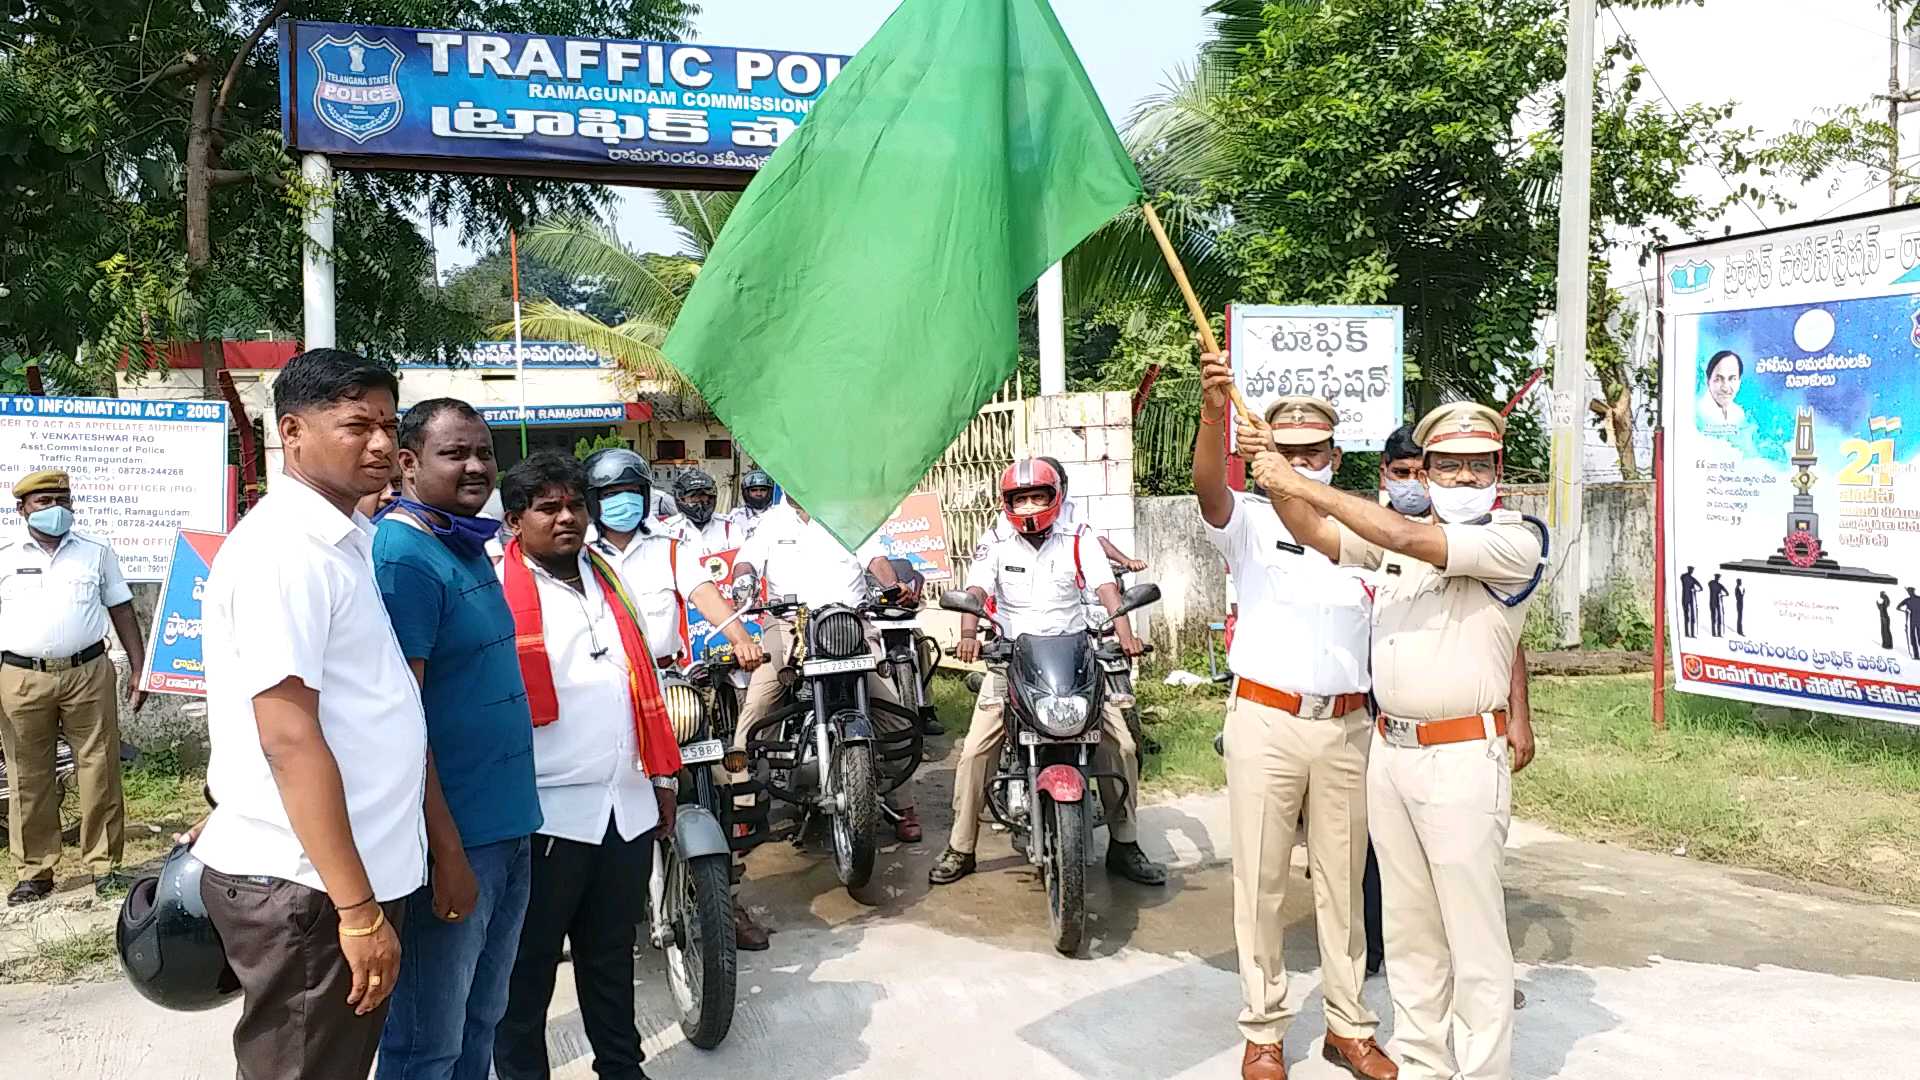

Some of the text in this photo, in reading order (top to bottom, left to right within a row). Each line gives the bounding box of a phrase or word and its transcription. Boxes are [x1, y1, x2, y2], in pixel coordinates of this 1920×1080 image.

[416, 33, 713, 87] TRAFFIC
[326, 72, 389, 86] TELANGANA STATE
[325, 83, 393, 102] POLICE
[528, 83, 677, 106] RAMAGUNDAM
[431, 101, 710, 145] ట్రాఫిక్
[608, 147, 708, 165] రామగుండం
[13, 398, 35, 413] TO
[38, 399, 142, 417] INFORMATION
[144, 402, 175, 418] ACT
[186, 404, 221, 419] 2005
[538, 407, 622, 419] RAMAGUNDAM
[0, 418, 21, 427] CER
[24, 420, 39, 428] TO
[43, 421, 63, 429] ACT
[30, 431, 155, 443] Y. VENKATESHWAR RAO
[122, 445, 132, 453] of
[135, 445, 165, 454] Police
[39, 453, 143, 465] Traffic Ramagundam
[1837, 438, 1894, 487] 21
[0, 463, 19, 472] Cell
[94, 466, 108, 474] PH
[71, 483, 114, 491] MATION
[71, 495, 139, 504] AMESH BABU
[2, 517, 21, 526] Cell
[95, 518, 108, 527] Ph
[127, 564, 142, 573] Cell
[1728, 639, 1808, 663] రామగుండం
[1704, 662, 1803, 692] రామగుండం
